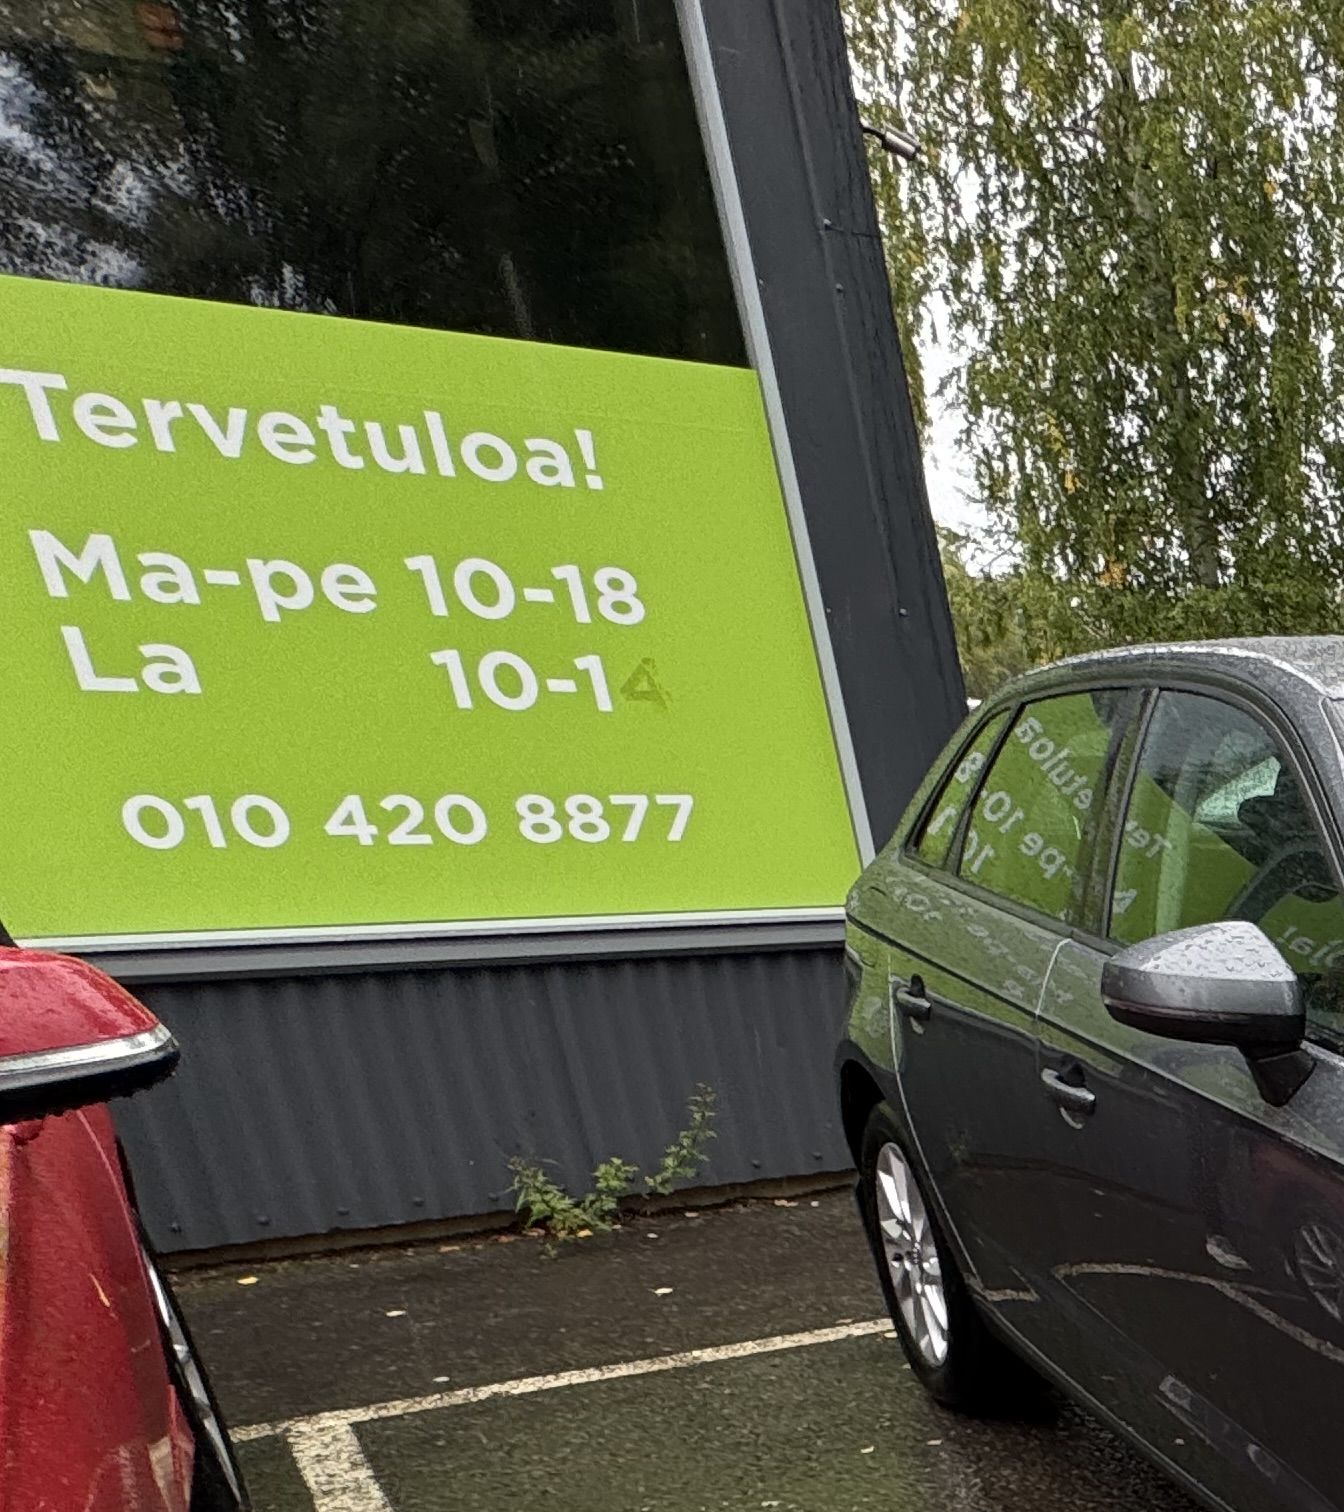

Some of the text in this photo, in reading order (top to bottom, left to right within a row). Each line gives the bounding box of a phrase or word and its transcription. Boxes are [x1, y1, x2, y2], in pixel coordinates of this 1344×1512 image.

[0, 368, 604, 491] Tervetuloa!
[29, 528, 646, 625] Ma-pe 10-18
[61, 625, 202, 694] La
[122, 793, 694, 849] 010 420 8877
